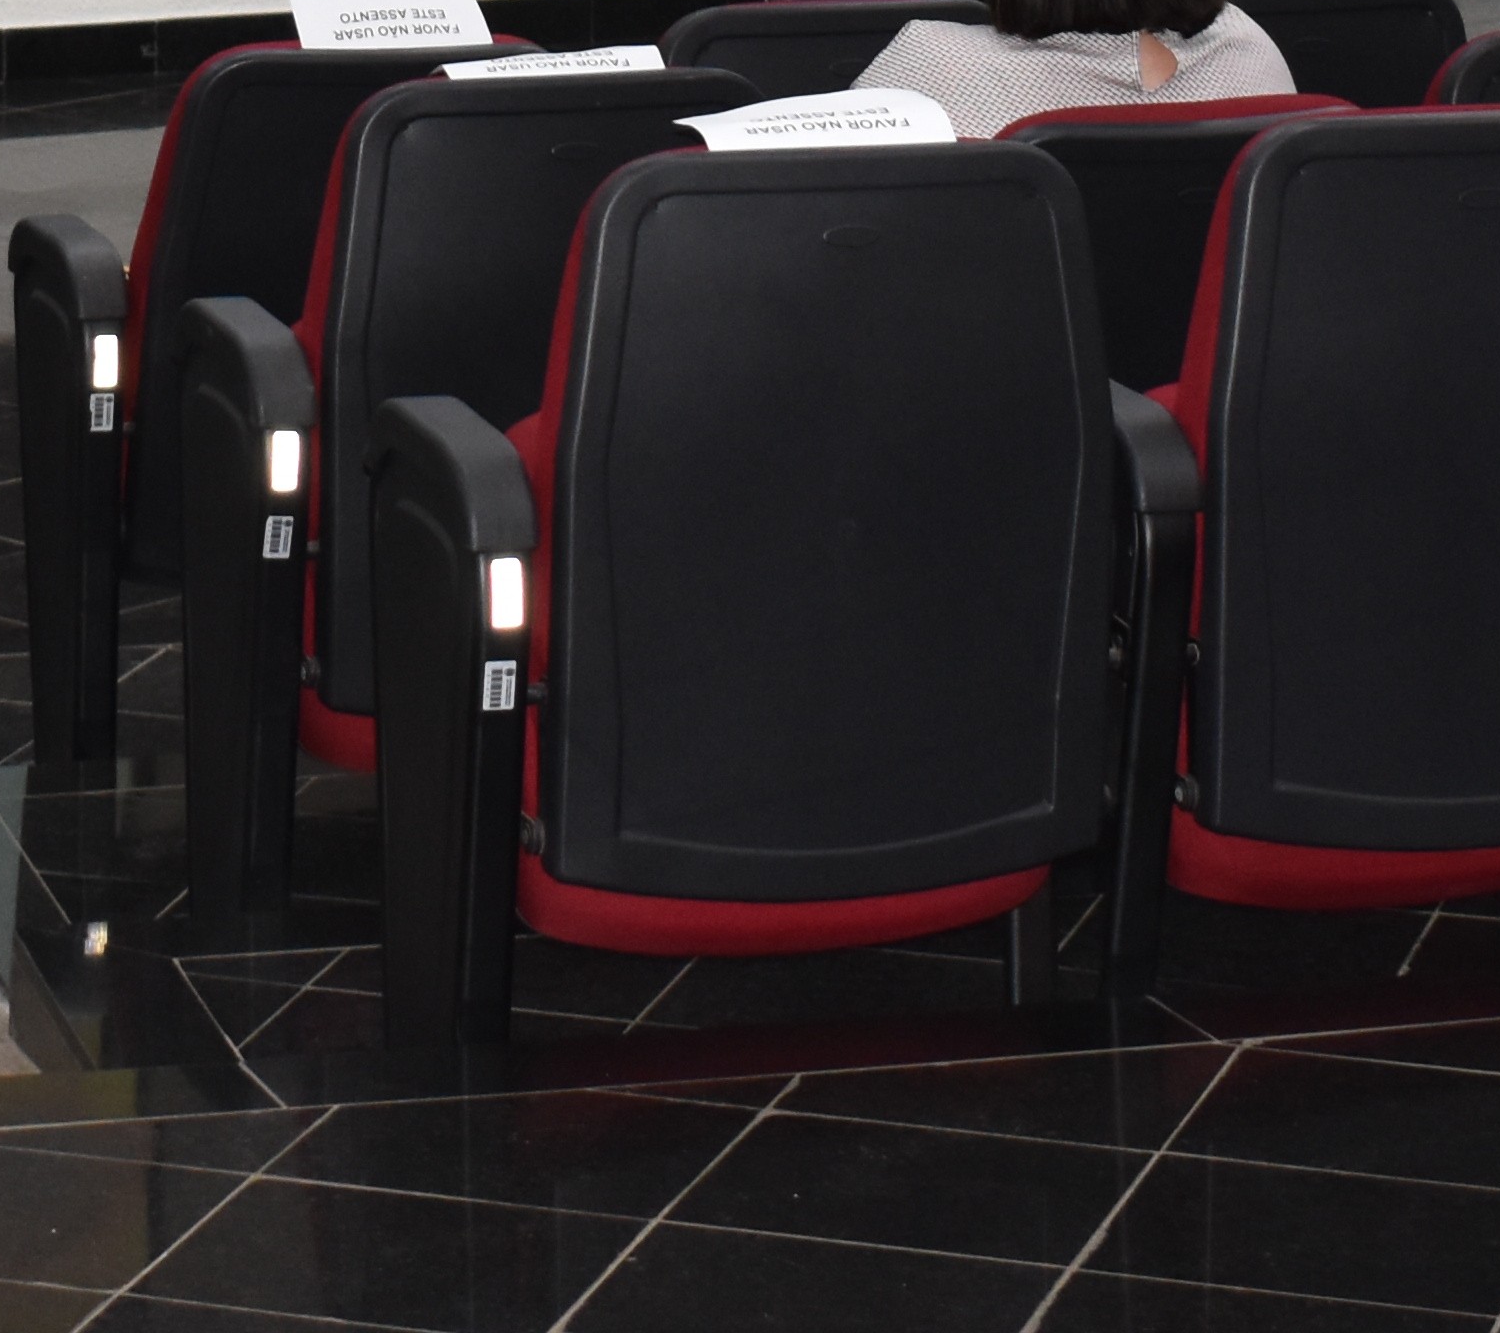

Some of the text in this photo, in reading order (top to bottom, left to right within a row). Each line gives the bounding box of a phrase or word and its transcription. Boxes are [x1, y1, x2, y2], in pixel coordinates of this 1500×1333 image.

[339, 8, 446, 23] ESTE ASSENTO
[333, 23, 460, 41] FAVOR NÃO USAR
[485, 57, 631, 73] FAVOR NÃO USAR
[844, 106, 889, 116] ESTE
[744, 117, 910, 135] FAVOR NÃO USAR
